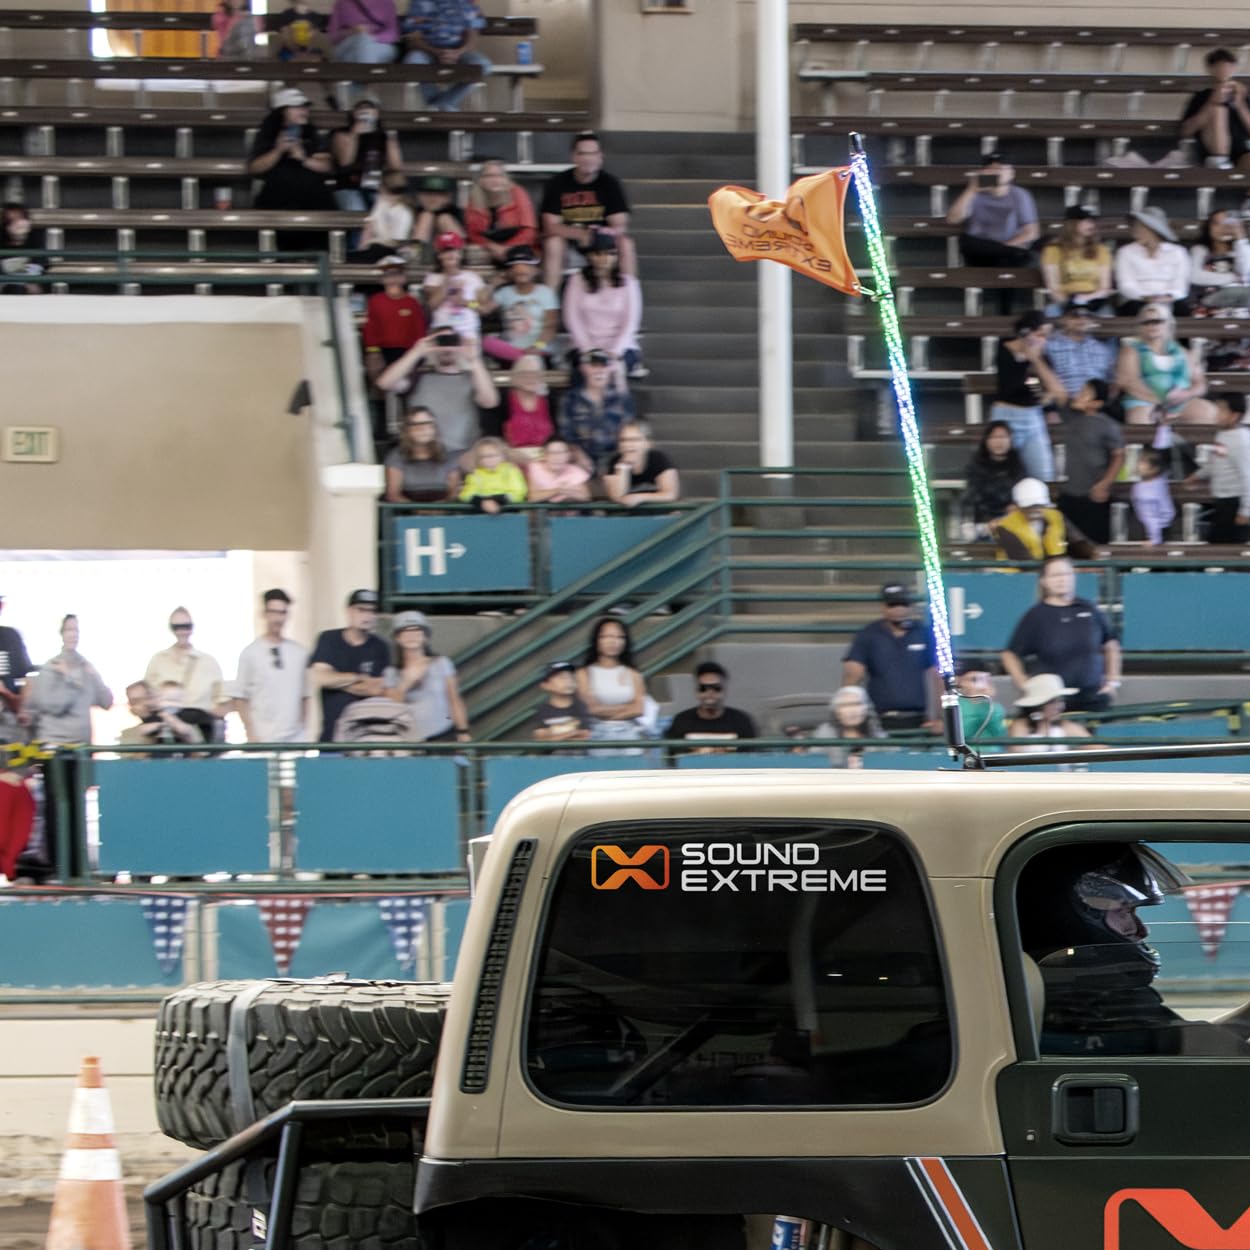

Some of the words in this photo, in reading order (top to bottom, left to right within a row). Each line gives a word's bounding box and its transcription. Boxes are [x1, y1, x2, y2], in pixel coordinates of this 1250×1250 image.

[405, 527, 447, 576] H
[681, 843, 819, 865] SOUND
[681, 869, 887, 892] EXTREME
